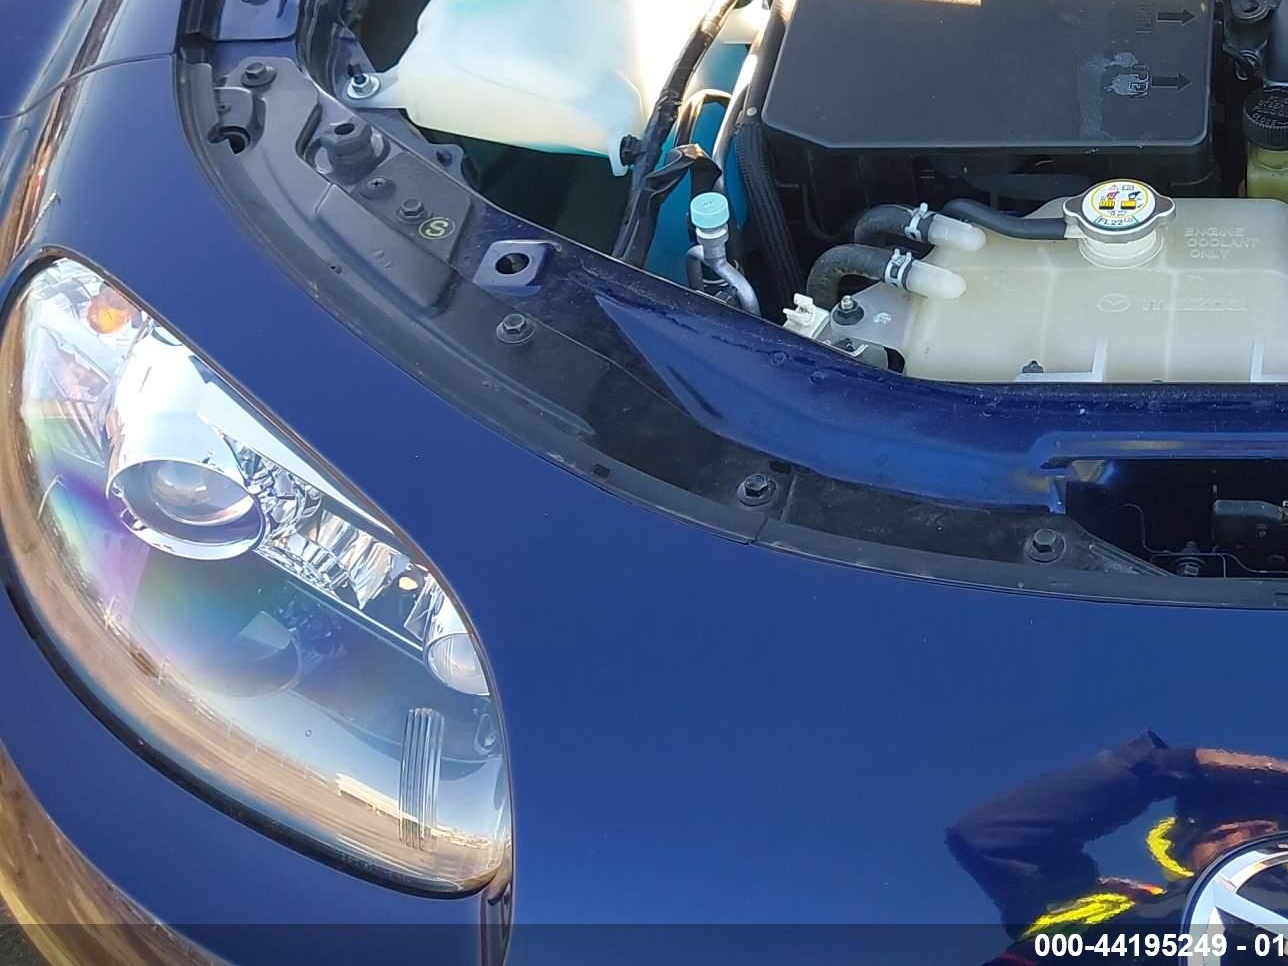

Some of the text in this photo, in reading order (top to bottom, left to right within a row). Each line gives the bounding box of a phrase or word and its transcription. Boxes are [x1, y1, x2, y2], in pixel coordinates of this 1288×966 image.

[1128, 63, 1150, 98] OPEN
[425, 220, 449, 237] S
[1183, 226, 1245, 237] ENGINE
[1187, 237, 1260, 249] COOLANT
[1190, 249, 1231, 259] ONLY
